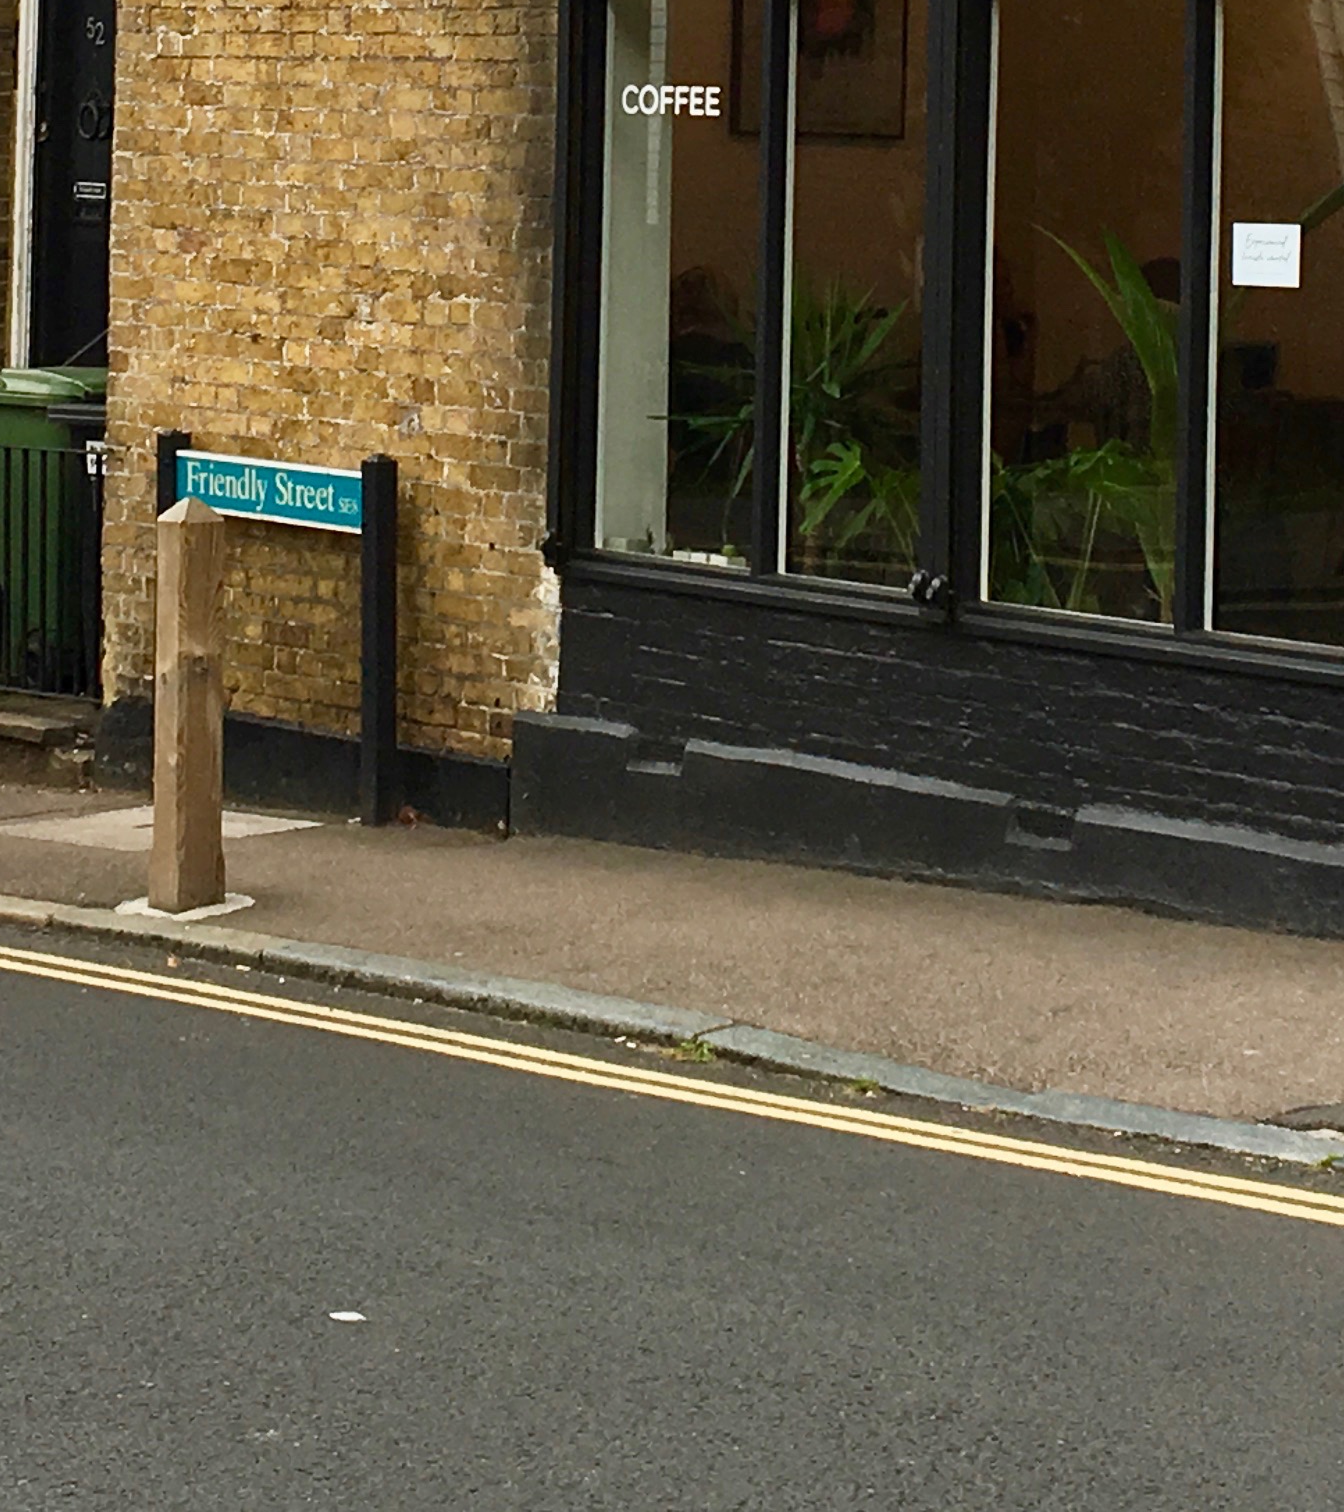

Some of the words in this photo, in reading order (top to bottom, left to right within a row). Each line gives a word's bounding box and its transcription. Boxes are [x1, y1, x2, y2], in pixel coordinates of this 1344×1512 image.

[85, 16, 105, 45] 52
[621, 84, 721, 116] COFFEE
[186, 461, 268, 511] Friendly
[275, 472, 335, 513] Street
